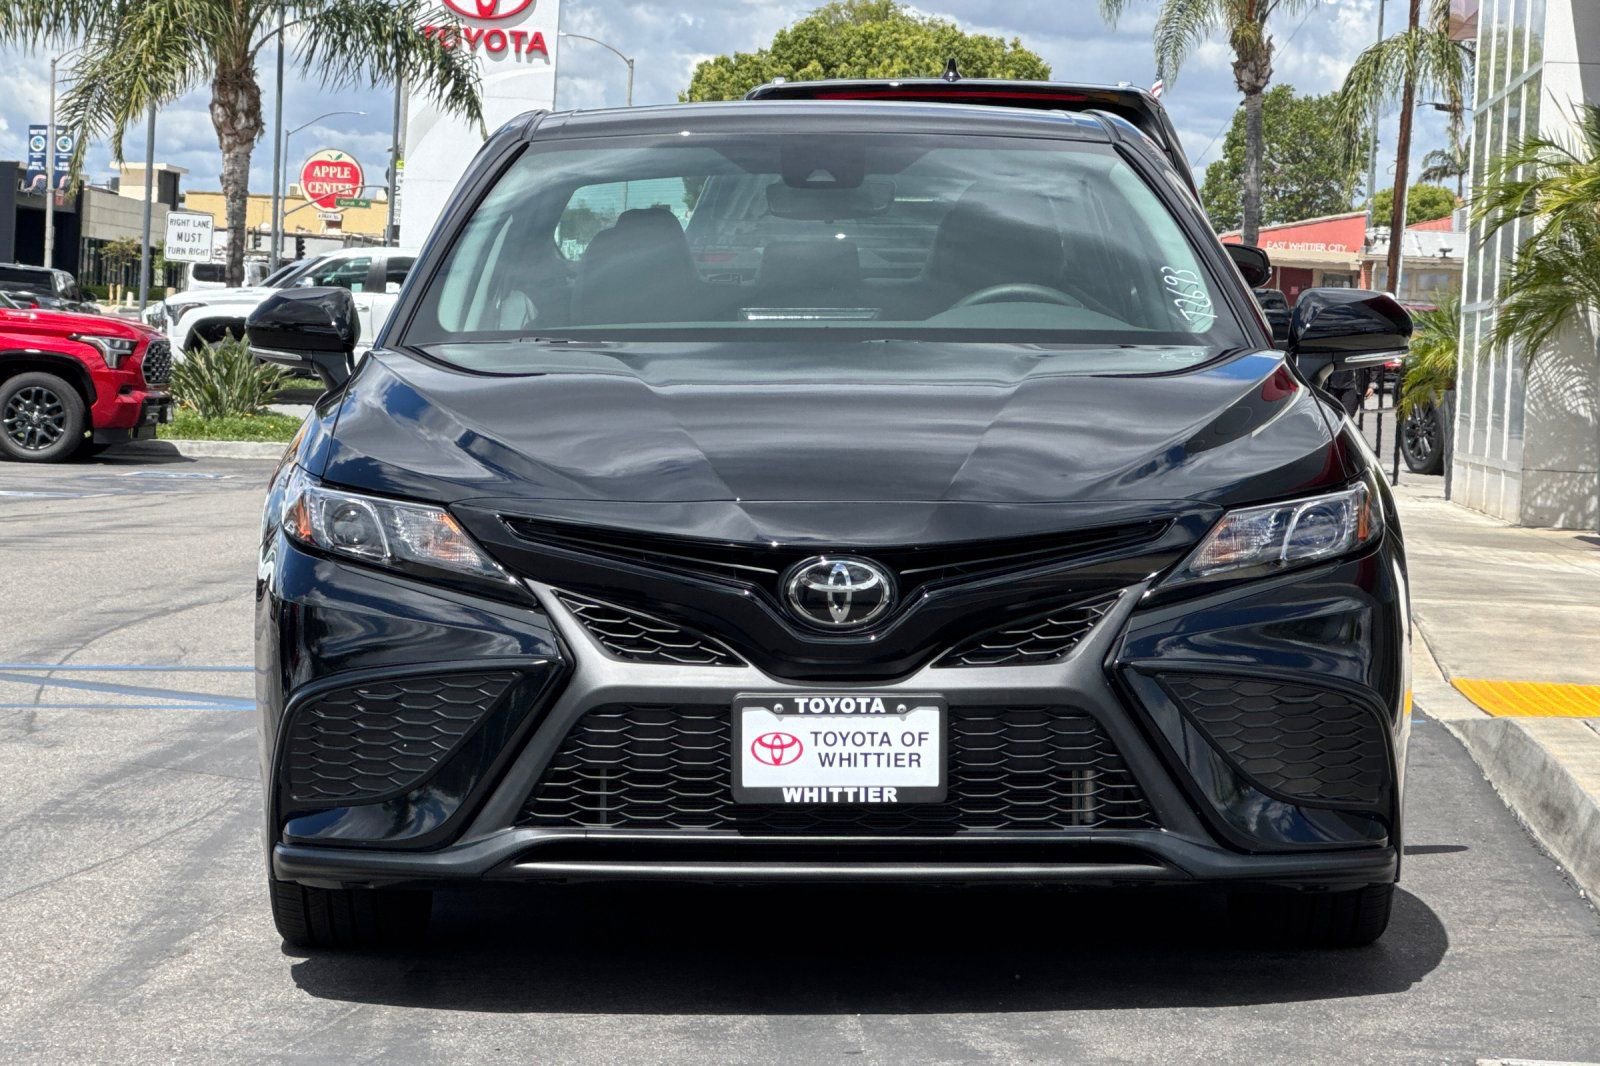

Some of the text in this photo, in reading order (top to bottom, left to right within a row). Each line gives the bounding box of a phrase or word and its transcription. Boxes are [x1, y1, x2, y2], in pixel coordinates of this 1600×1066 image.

[313, 165, 351, 178] APPLE
[307, 181, 353, 195] CENTER
[169, 218, 211, 229] RIGHT LANE
[177, 231, 202, 243] MUST
[167, 246, 209, 257] TURN RIGHT
[1266, 241, 1348, 253] EAST WHITTIER CITY
[794, 697, 887, 714] TOYOTA
[810, 731, 930, 747] TOYOTA OF
[818, 752, 922, 768] WHITTIER
[782, 787, 898, 803] WHITTIER
